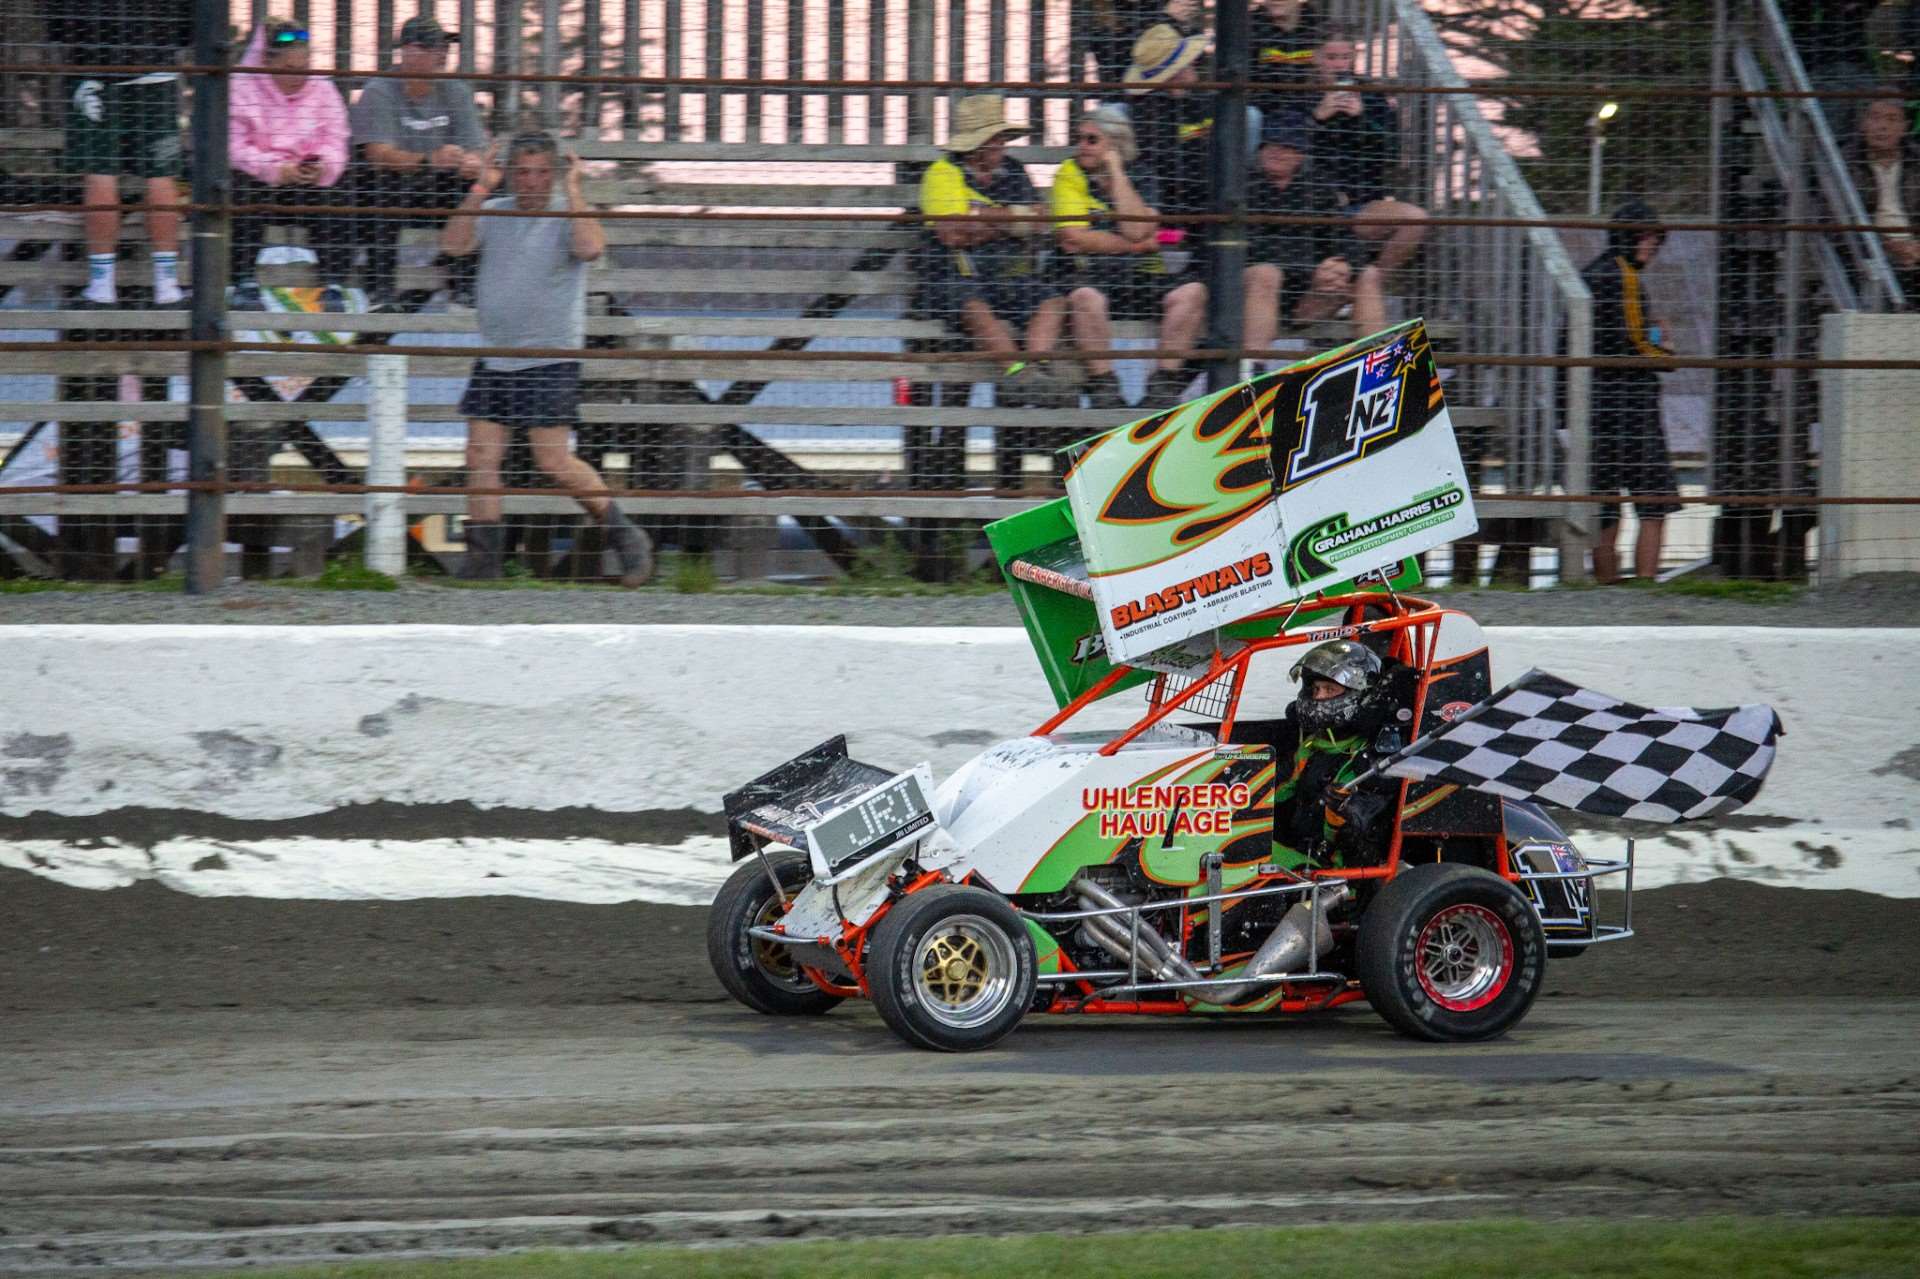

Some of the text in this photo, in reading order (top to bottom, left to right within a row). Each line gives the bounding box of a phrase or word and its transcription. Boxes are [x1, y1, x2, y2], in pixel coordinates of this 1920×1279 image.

[1348, 386, 1398, 438] NZ
[1314, 491, 1462, 553] GRAHAM HARRIS LTD
[1110, 552, 1274, 631] BLASTWAYS
[1122, 578, 1273, 640] INDUSTRIAL COATINGS ABRASIVE BLASTING
[849, 780, 920, 847] JRI
[1081, 783, 1249, 811] UHLENBERG
[1099, 810, 1232, 838] HAULAGE
[905, 816, 930, 837] LIMITED
